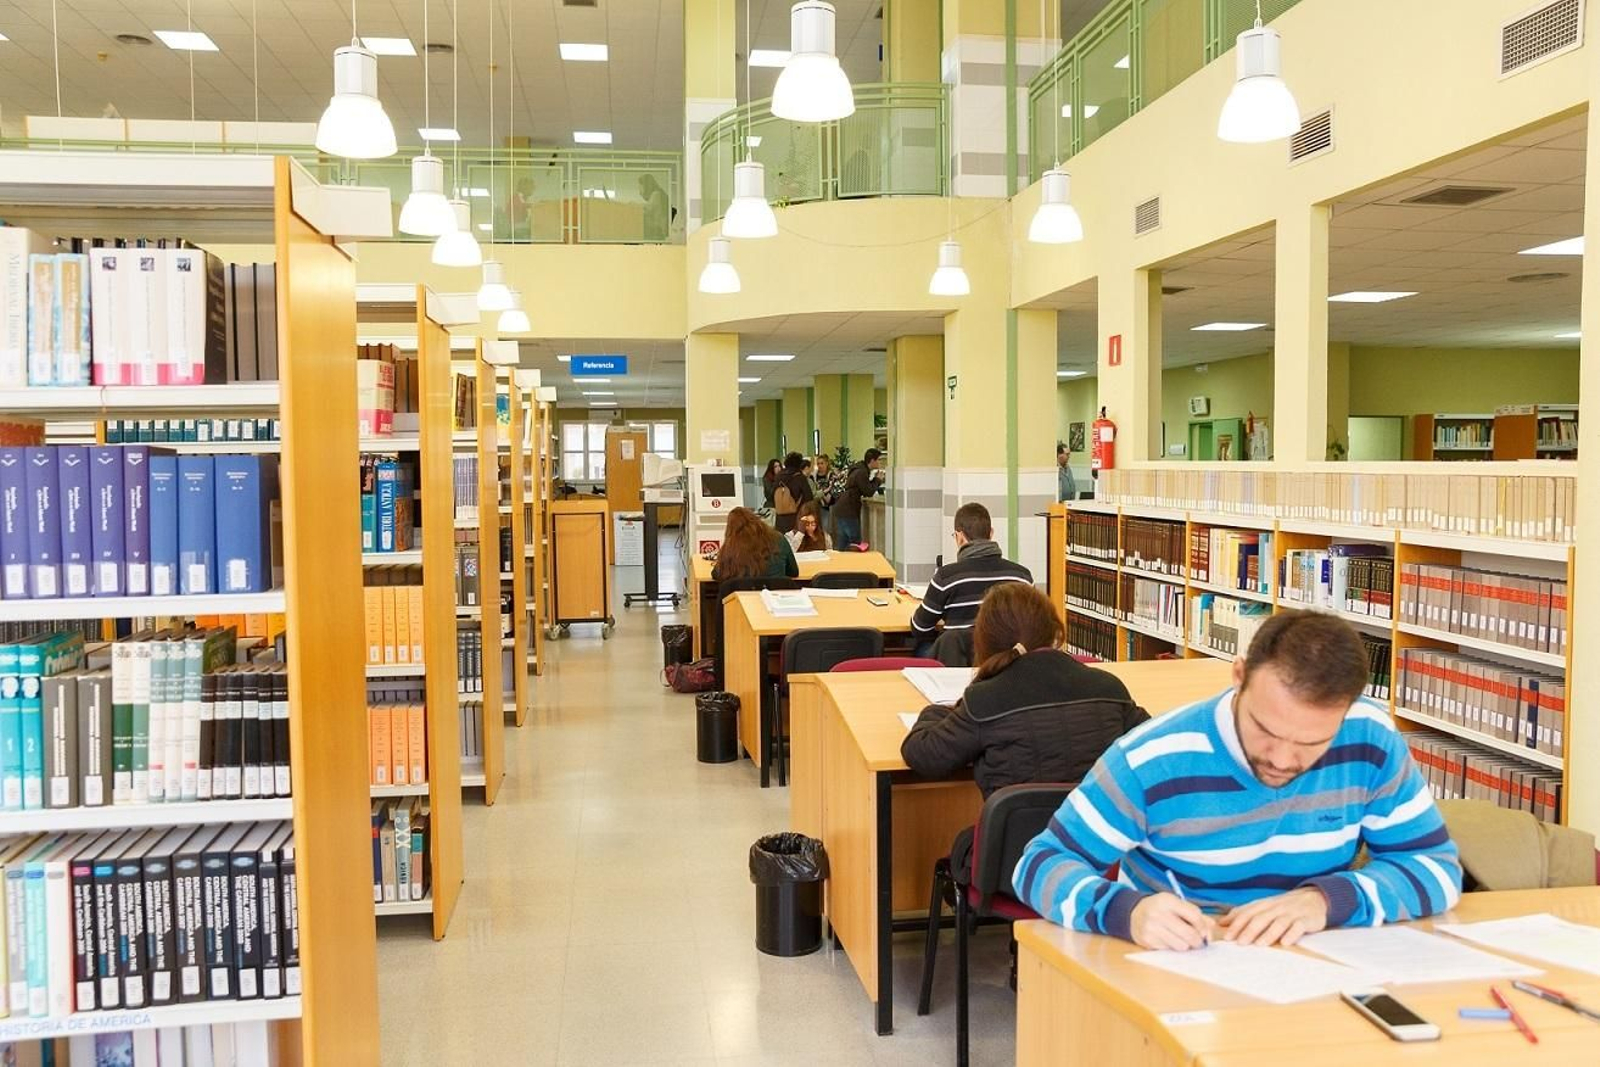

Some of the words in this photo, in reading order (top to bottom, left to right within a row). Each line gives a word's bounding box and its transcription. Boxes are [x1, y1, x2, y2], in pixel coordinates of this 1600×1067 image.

[7, 738, 13, 751] 1
[27, 738, 34, 752] 2
[176, 877, 184, 914] CARIBBEAN
[184, 877, 192, 906] CENTRAL
[205, 877, 213, 913] CARIBBEAN
[220, 876, 228, 897] SOUTH
[118, 883, 127, 920] CARIBBEAN
[145, 881, 154, 917] CARIBBEAN
[235, 890, 243, 928] CARIBBEAN
[153, 881, 161, 910] CENTRAL
[157, 955, 165, 969] THE
[215, 936, 223, 949] AND
[244, 938, 252, 953] AND
[129, 958, 137, 971] THE
[216, 950, 224, 963] THE
[0, 1021, 64, 1035] HISTORIA
[67, 1018, 87, 1030] DE
[90, 1014, 152, 1028] AMERICA
